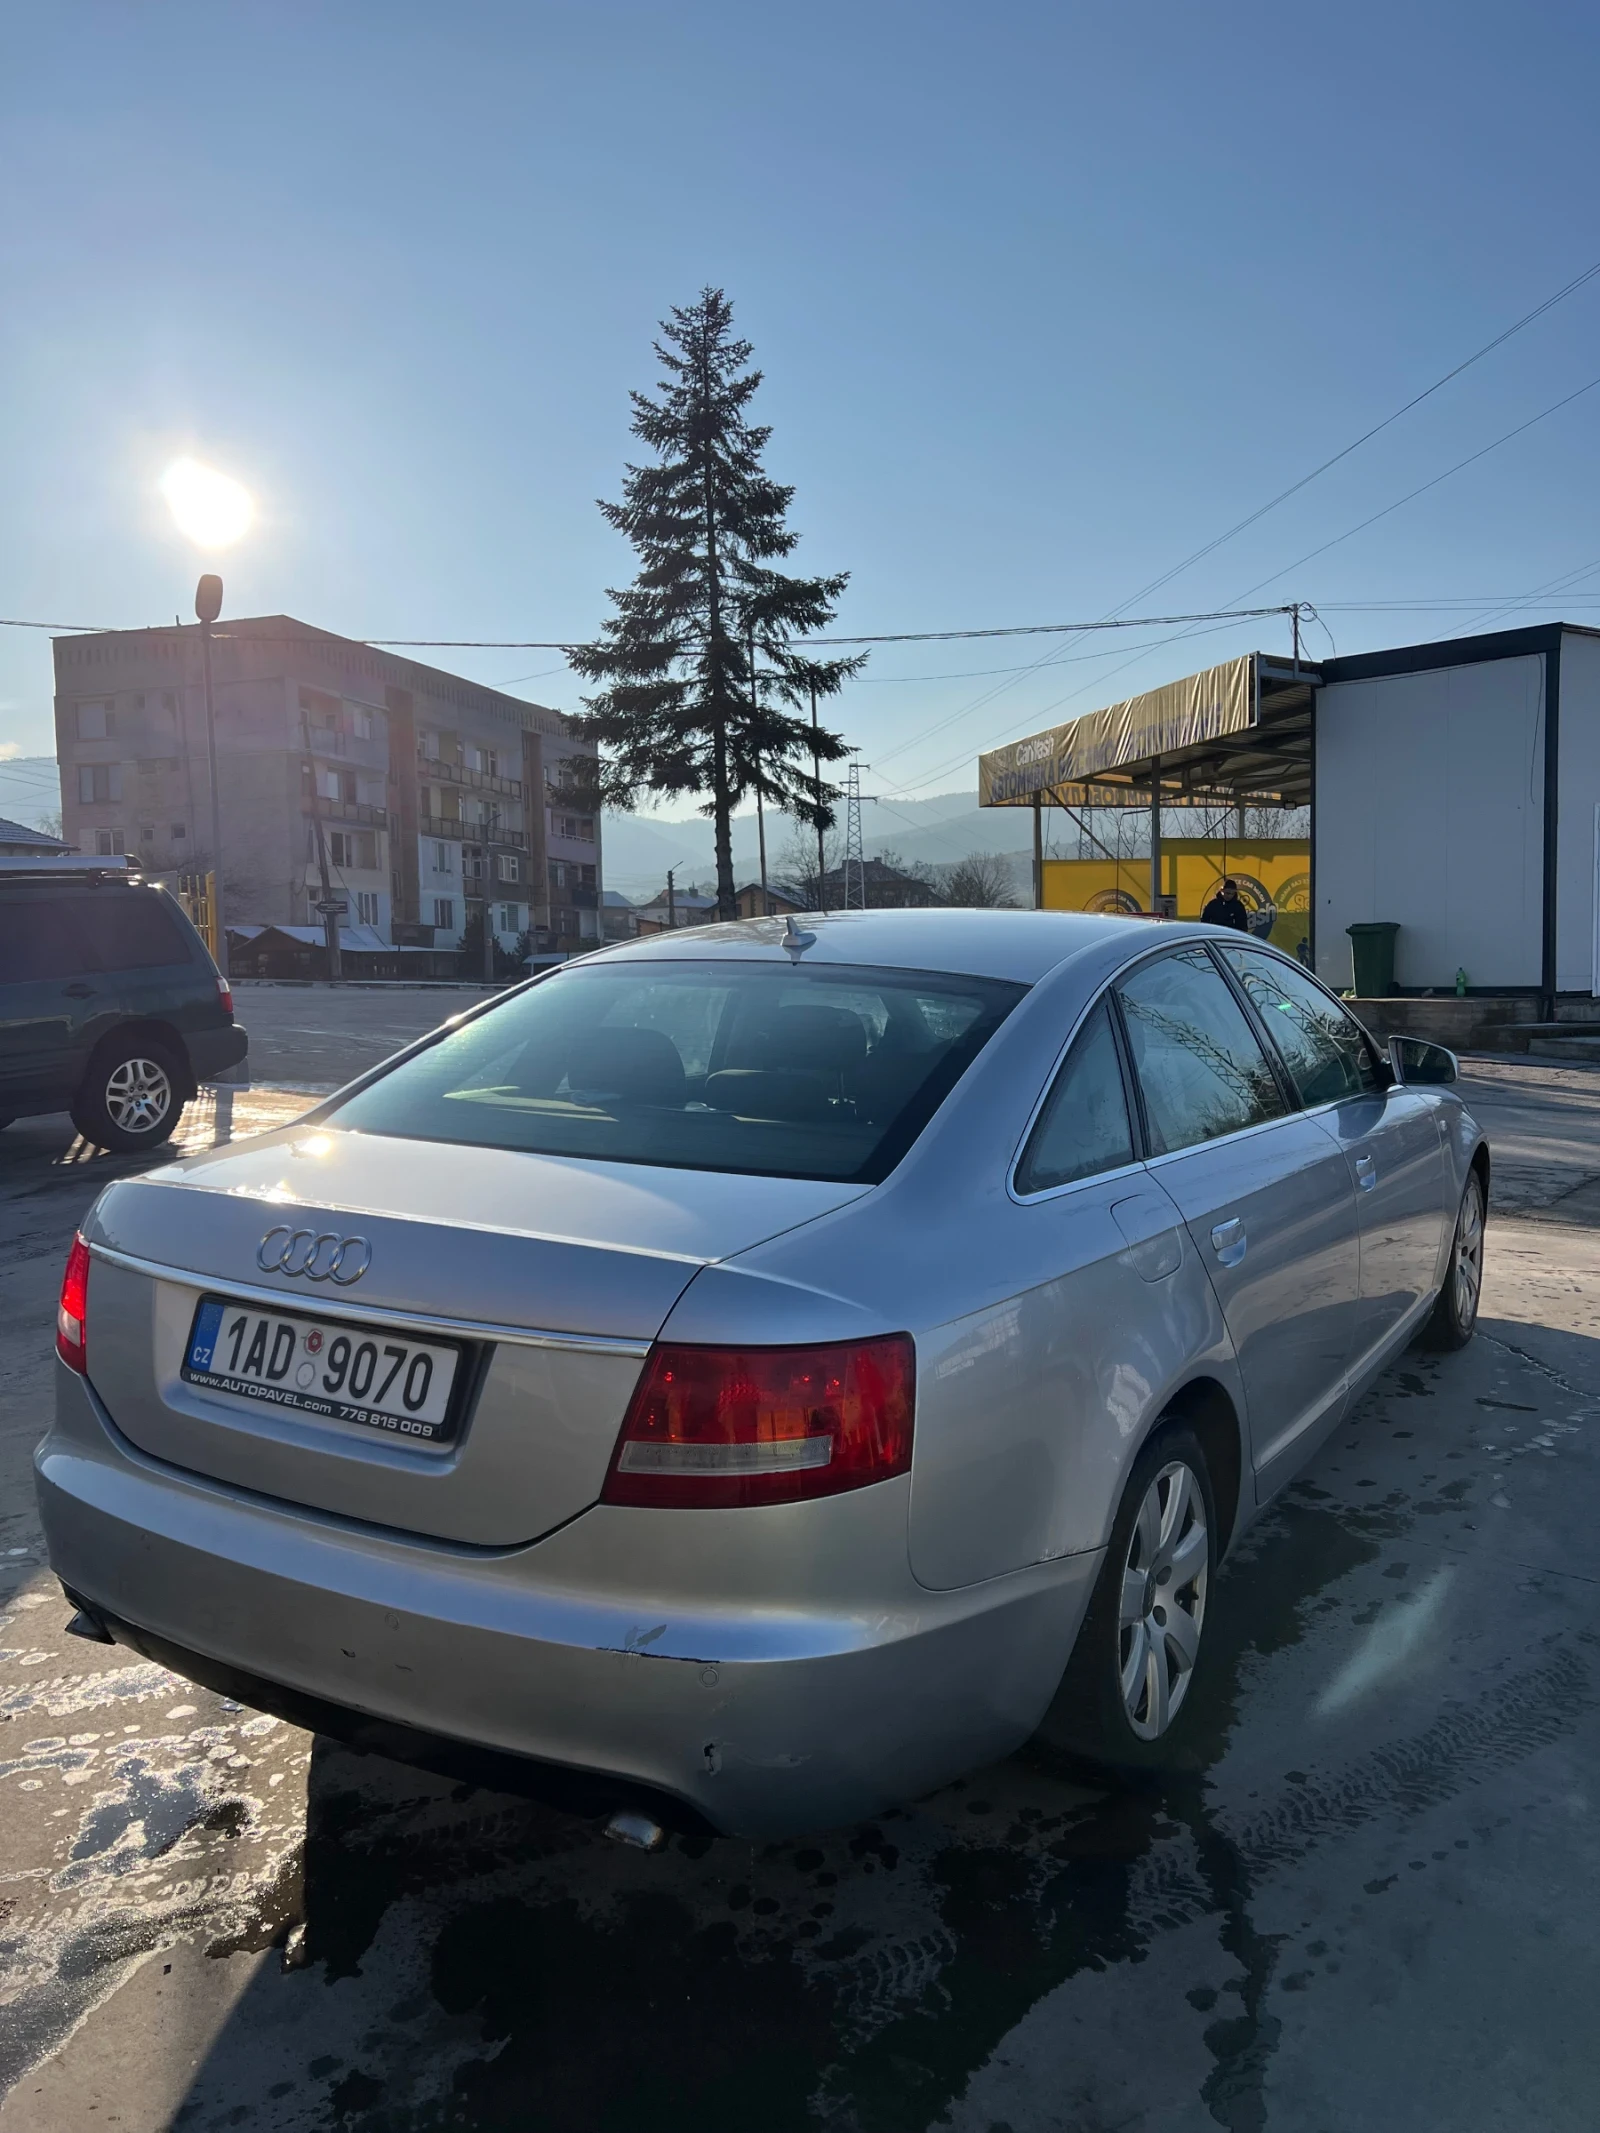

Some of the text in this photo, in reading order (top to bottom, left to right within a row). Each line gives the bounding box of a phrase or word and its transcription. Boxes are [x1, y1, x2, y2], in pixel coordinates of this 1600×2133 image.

[1015, 733, 1055, 767] CarWash
[192, 1346, 211, 1364] CZ
[227, 1316, 434, 1411] 1AD 9070
[189, 1372, 433, 1437] www.AUTOPAVEL.com 776 815 009
